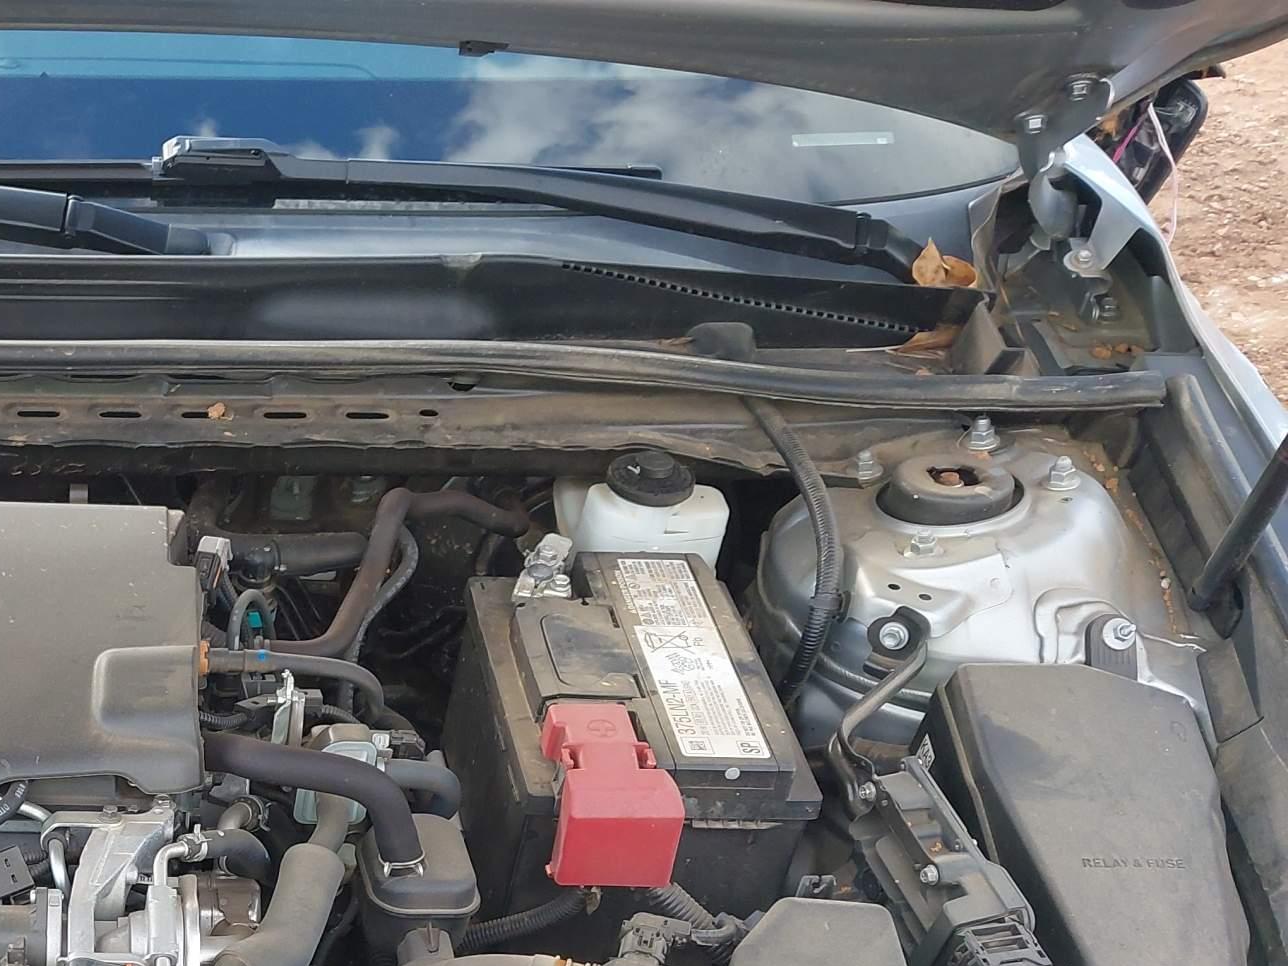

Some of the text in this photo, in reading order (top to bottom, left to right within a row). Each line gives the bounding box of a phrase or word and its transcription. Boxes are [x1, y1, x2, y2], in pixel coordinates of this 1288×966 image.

[658, 679, 697, 736] 375LN2-MF
[742, 741, 761, 754] SP
[1082, 857, 1185, 869] RELAY & FUSE
